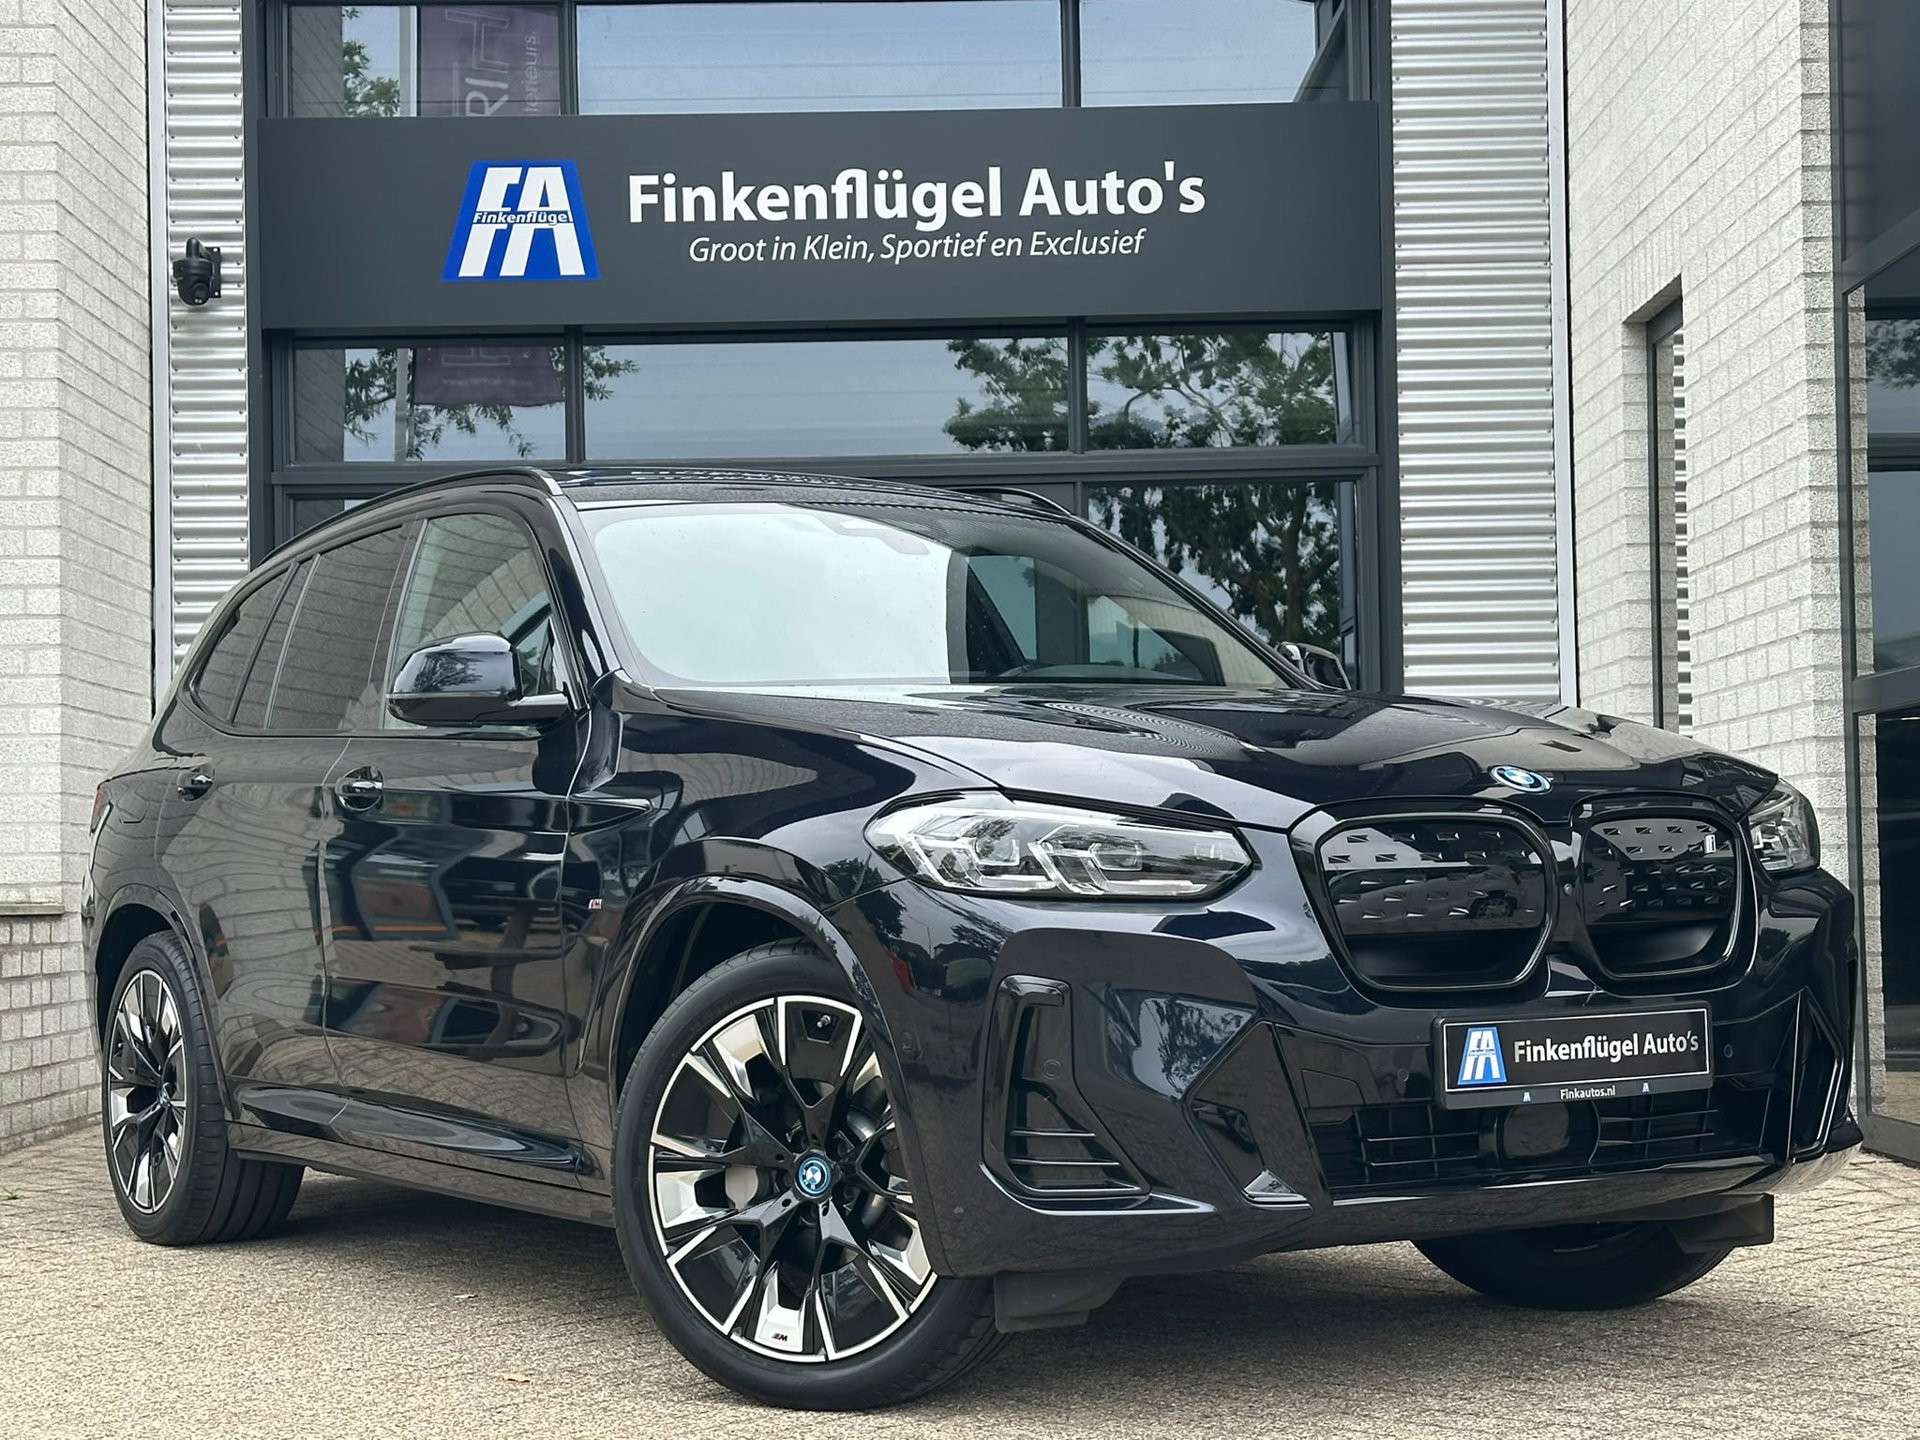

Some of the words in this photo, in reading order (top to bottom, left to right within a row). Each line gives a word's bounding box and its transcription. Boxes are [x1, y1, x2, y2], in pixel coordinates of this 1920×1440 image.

[628, 168, 1003, 232] Finkenflügel
[1018, 160, 1207, 219] Auto's
[472, 211, 574, 227] Finkenflügel
[689, 236, 767, 263] Groot
[771, 234, 798, 262] in
[803, 234, 876, 263] Klein,
[879, 230, 988, 265] Sportief
[990, 237, 1024, 258] en
[1029, 227, 1148, 257] Exclusief
[1513, 1032, 1639, 1064] Finkenflügel
[1559, 1084, 1617, 1101] Finkautos.nl
